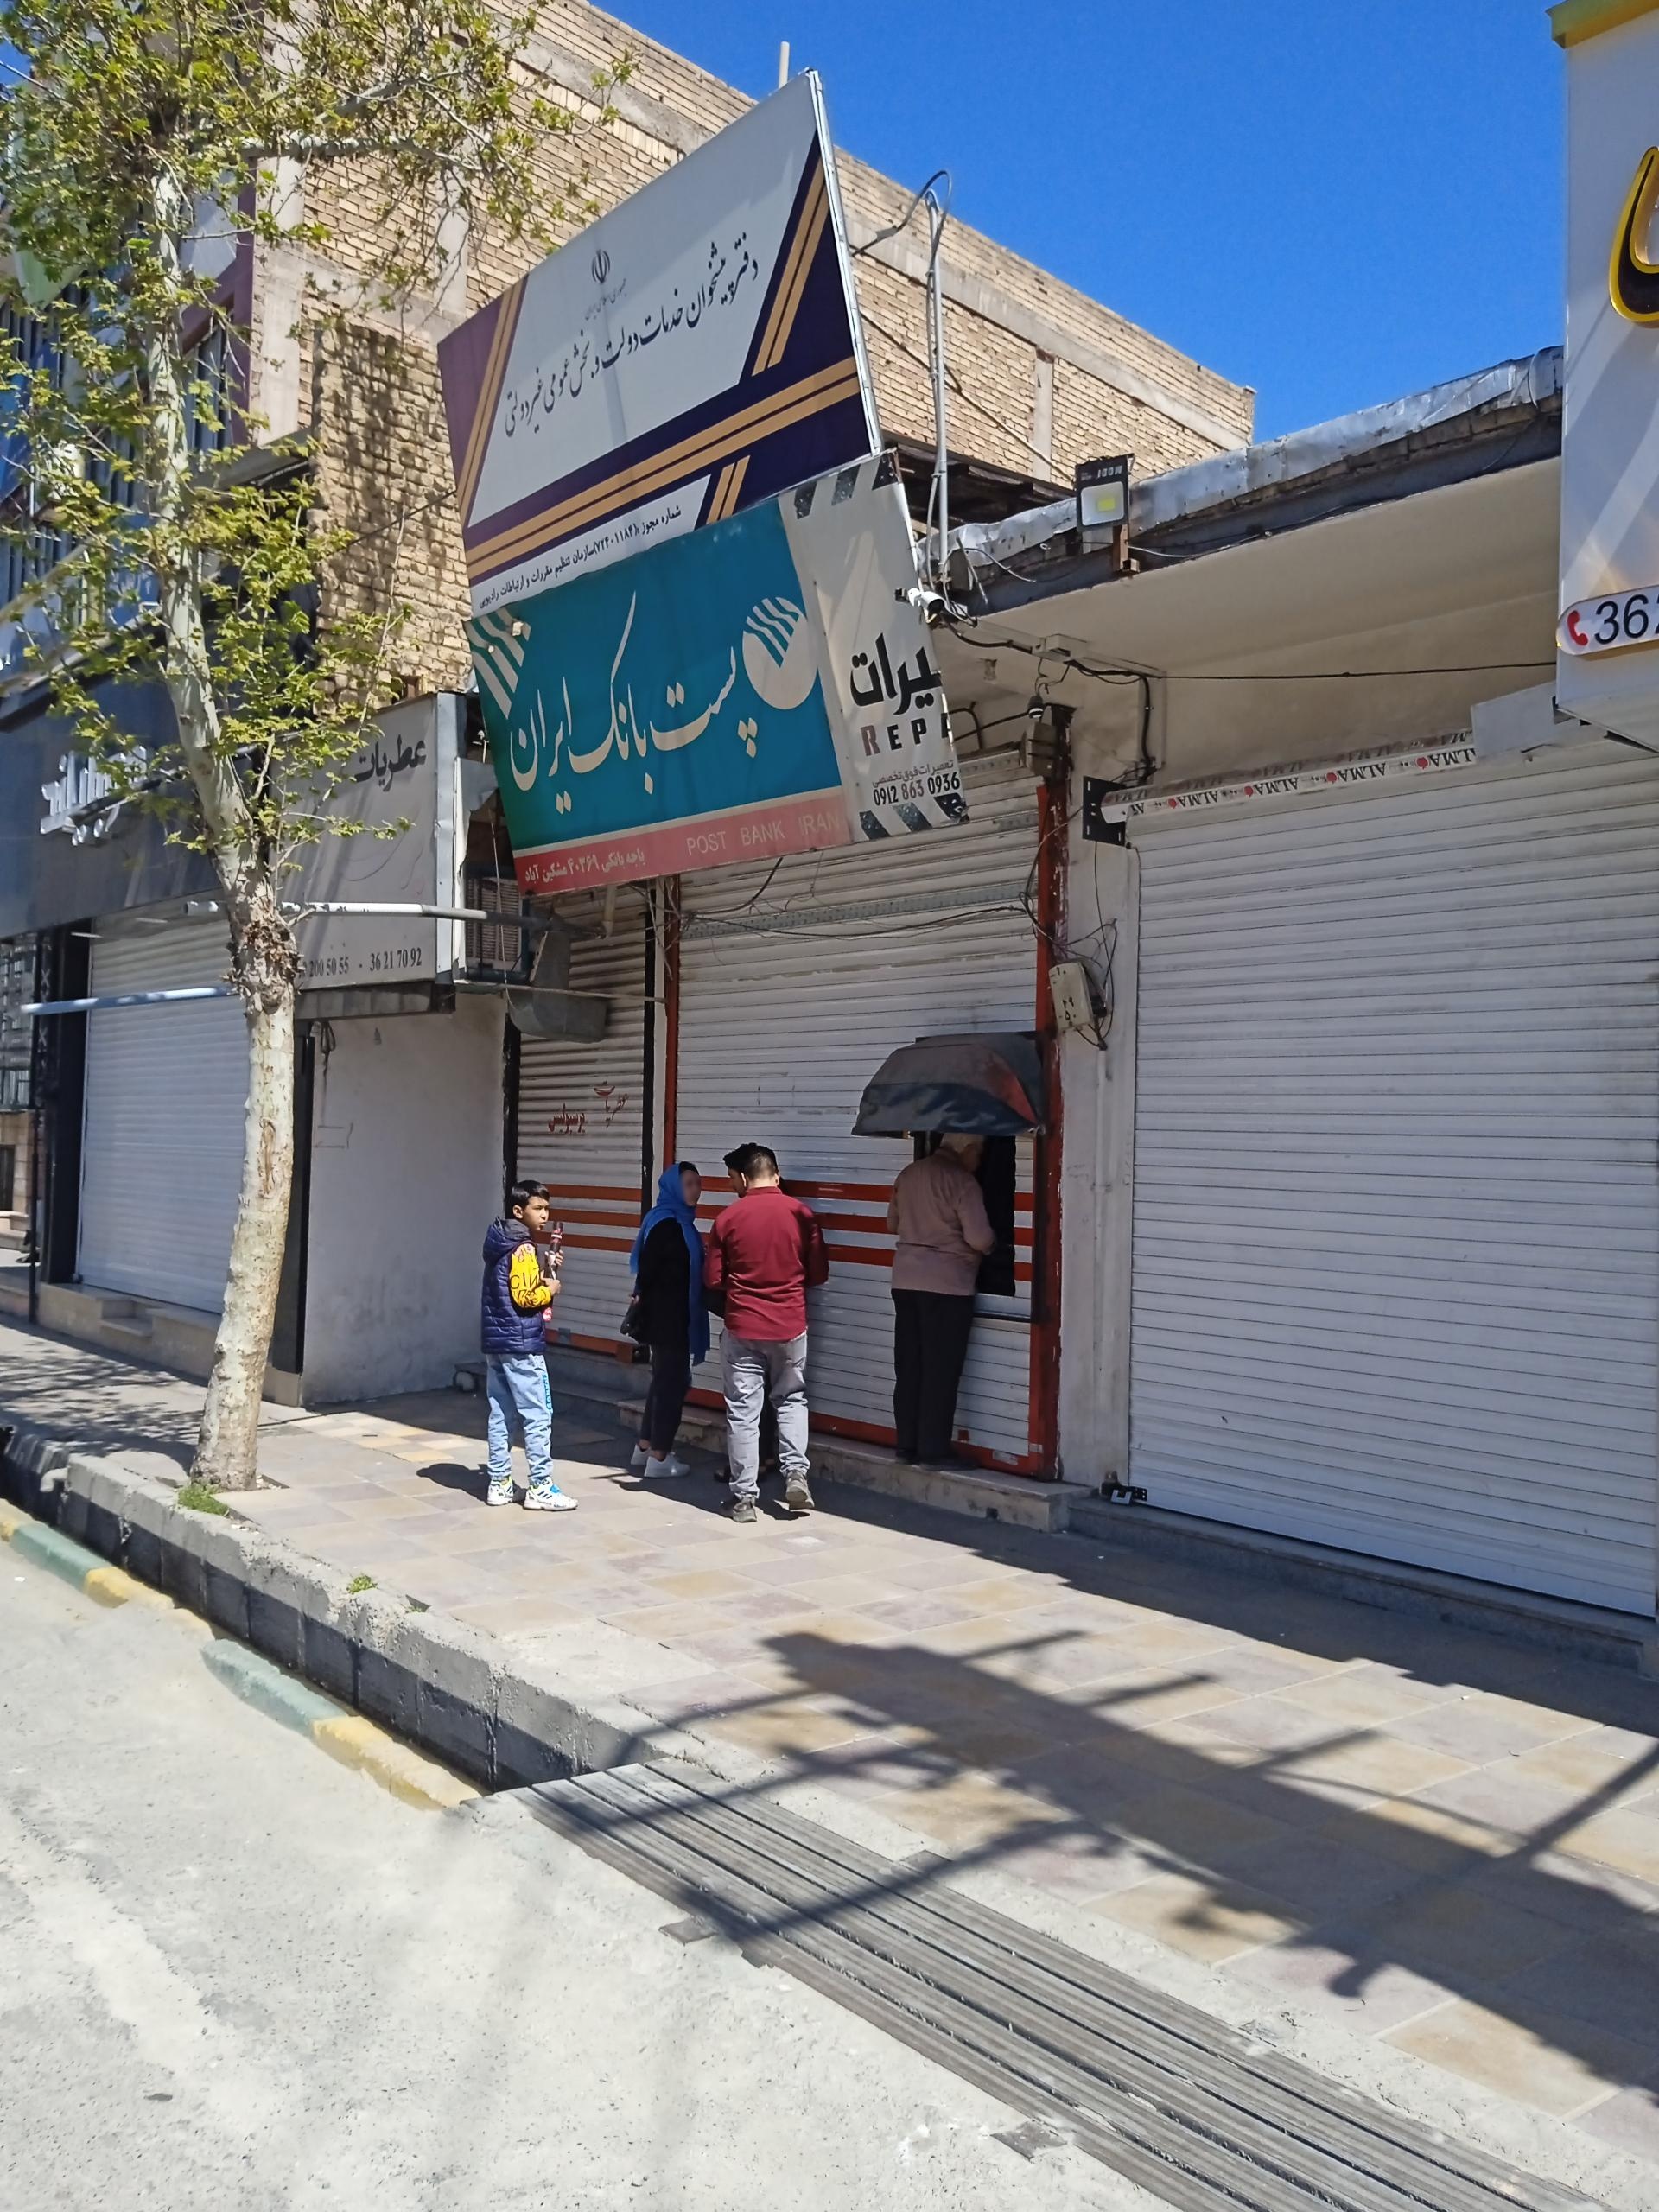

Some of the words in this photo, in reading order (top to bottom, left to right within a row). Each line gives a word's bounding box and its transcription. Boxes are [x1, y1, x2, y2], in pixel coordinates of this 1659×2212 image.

[686, 241, 734, 328] پیشخوان
[729, 232, 759, 305] دفتر
[640, 288, 683, 346] خدمات
[569, 329, 594, 397] بخش
[601, 326, 639, 369] دولت
[543, 359, 569, 414] عمومی
[642, 518, 660, 535] مجوز
[661, 505, 682, 524] شماره
[531, 566, 553, 582] مقررات
[555, 556, 571, 578] تنظیم
[500, 575, 524, 596] ارتباطات
[567, 590, 654, 794] بانک
[650, 645, 758, 759] پست
[510, 676, 572, 815] ایران
[354, 734, 427, 792] عطریات
[1339, 762, 1386, 783] ALMA
[873, 785, 899, 806] 0912
[901, 779, 925, 800] 863
[927, 772, 961, 795] 0936
[1176, 790, 1219, 809] ALMA
[1253, 778, 1299, 796] ALMA
[686, 831, 727, 856] POST
[740, 821, 785, 847] BANK
[798, 811, 840, 836] IRAN
[524, 864, 540, 884] آباد
[602, 851, 625, 874] بانکی
[626, 847, 646, 867] باجه
